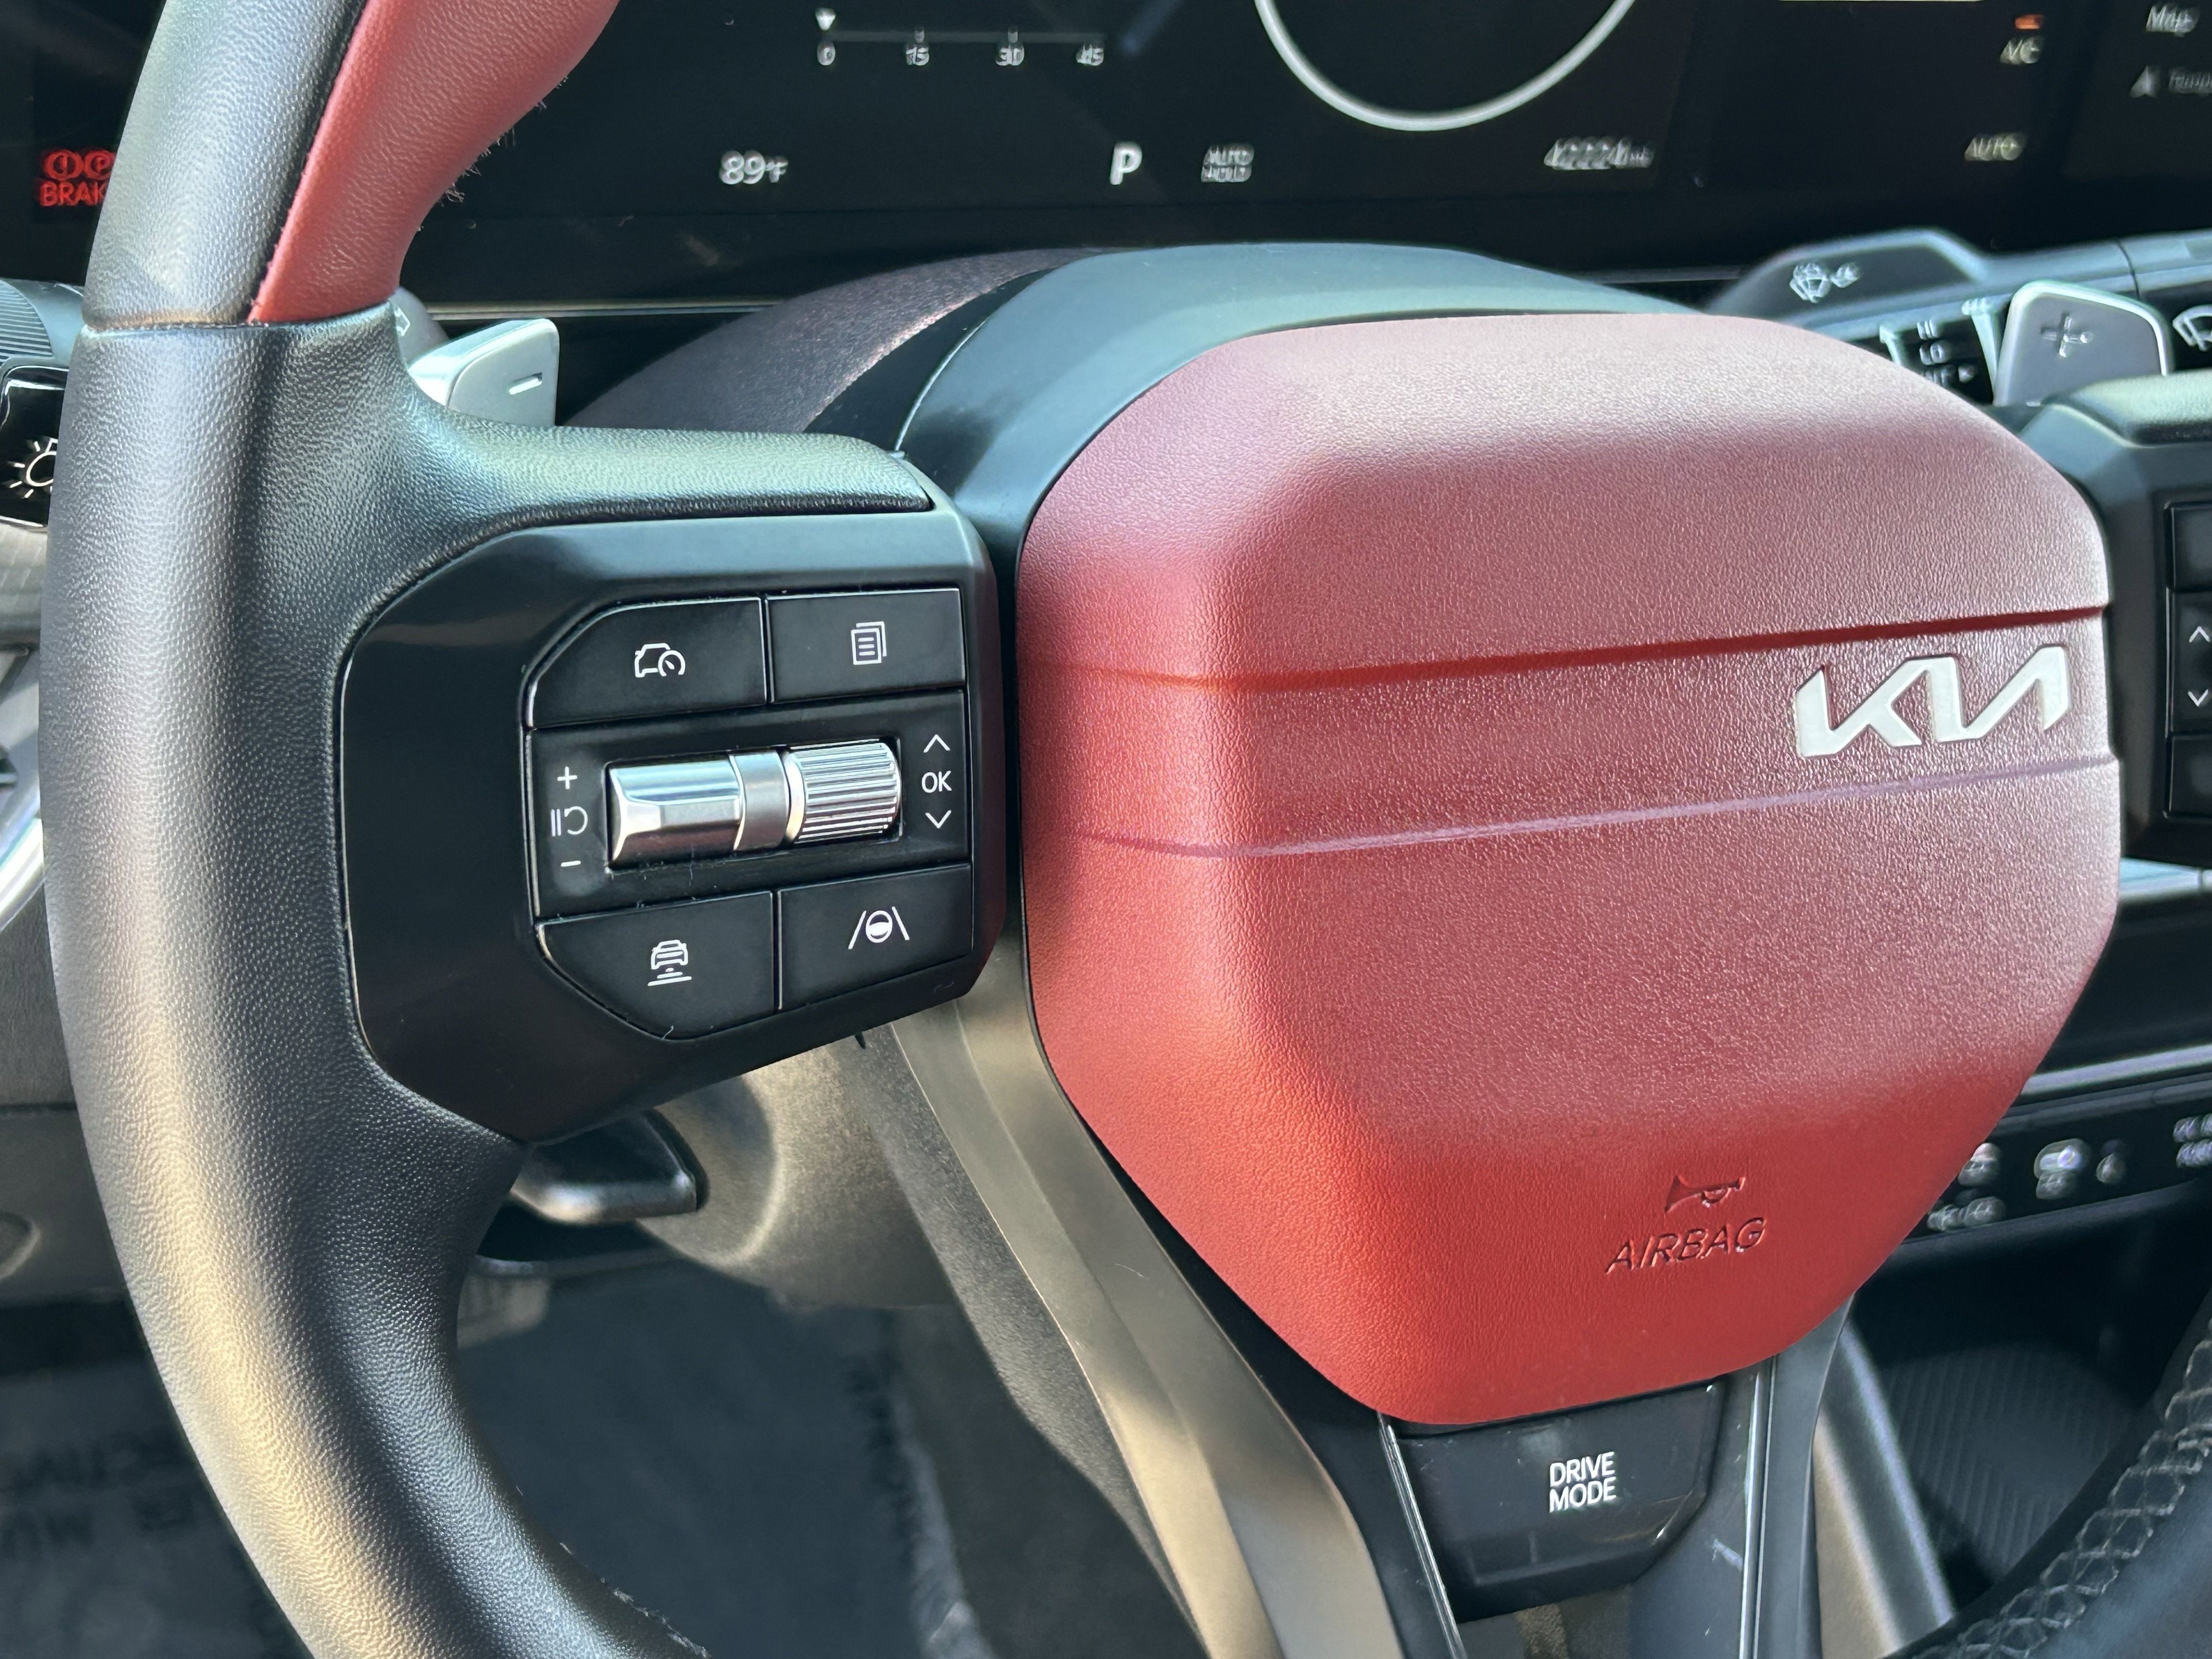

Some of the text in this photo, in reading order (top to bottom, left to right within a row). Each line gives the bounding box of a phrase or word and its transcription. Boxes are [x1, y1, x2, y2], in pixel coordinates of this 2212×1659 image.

[817, 42, 836, 65] 0
[906, 44, 929, 66] 15
[996, 43, 1024, 66] 30
[1110, 141, 1142, 185] P
[1965, 133, 2025, 161] AUTO
[1795, 644, 2072, 757] KIA
[922, 770, 952, 793] OK
[1604, 1216, 1767, 1276] AIRBAG
[1549, 1451, 1615, 1488] DRIVE
[1549, 1476, 1617, 1513] MODE
